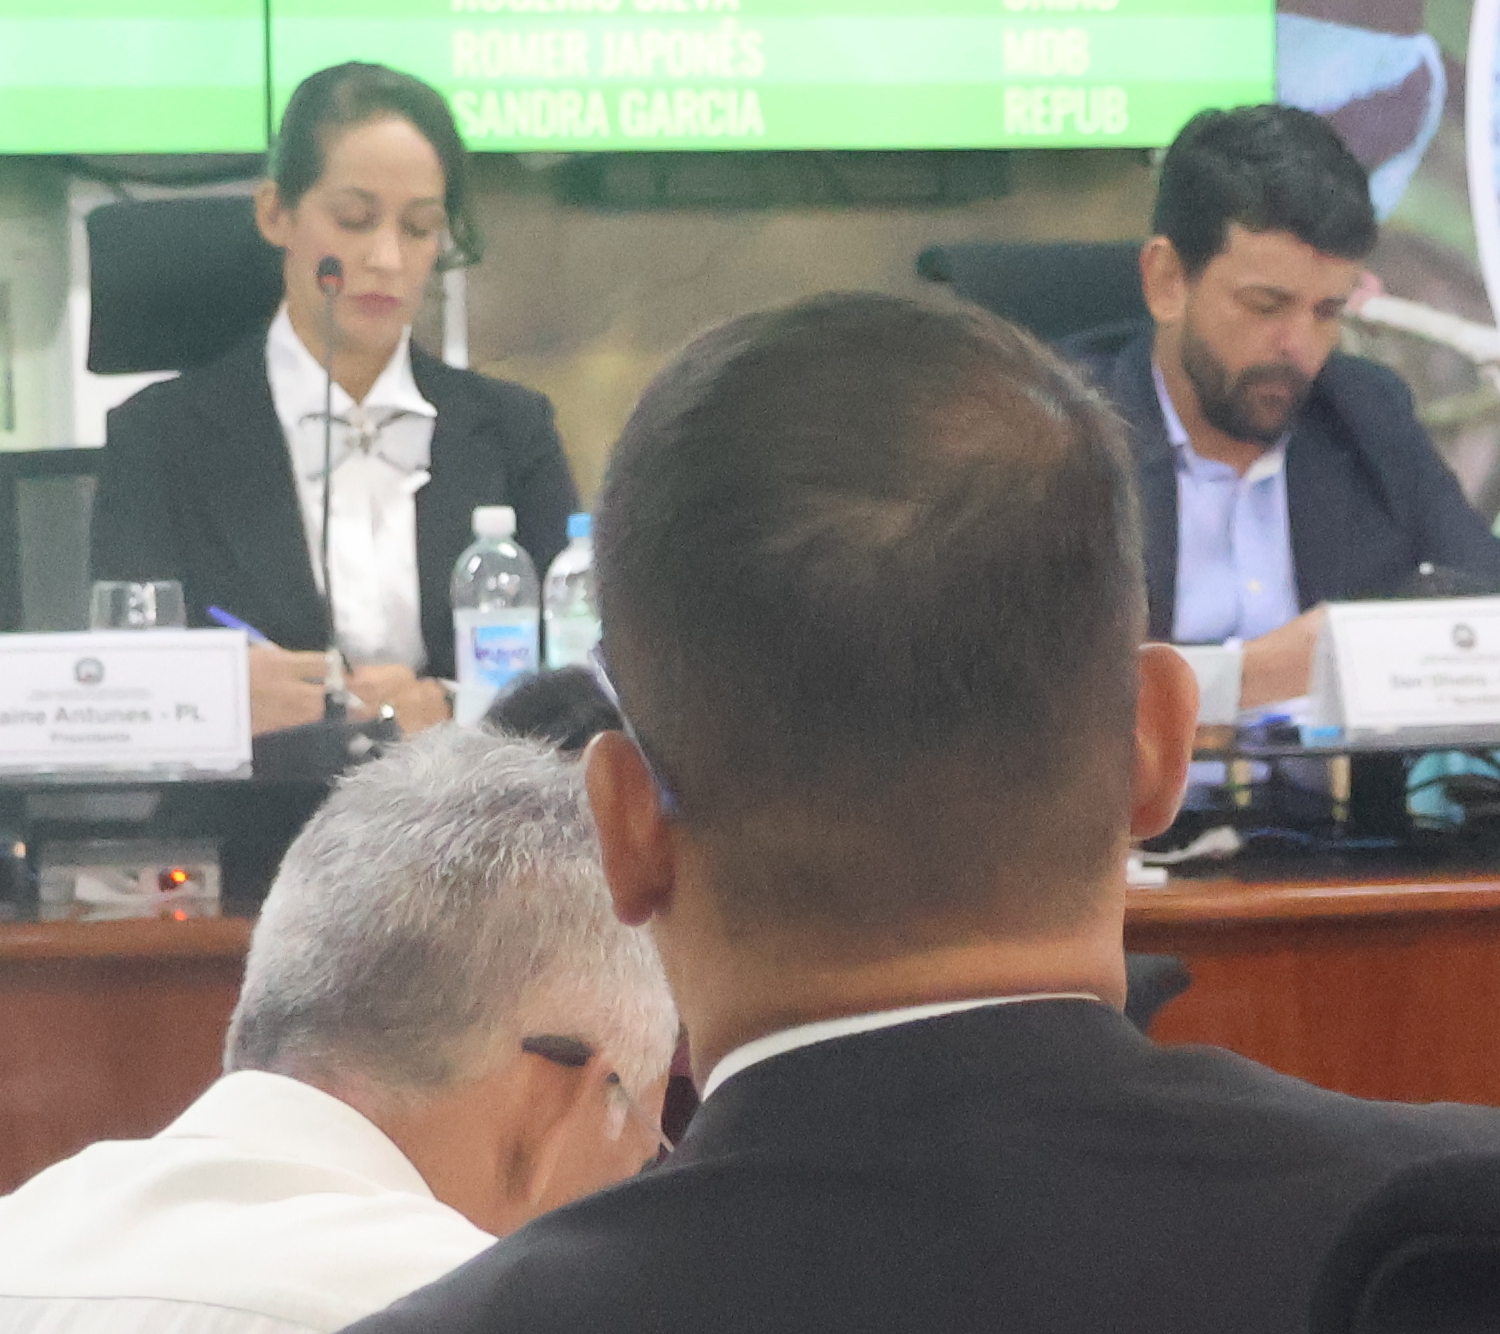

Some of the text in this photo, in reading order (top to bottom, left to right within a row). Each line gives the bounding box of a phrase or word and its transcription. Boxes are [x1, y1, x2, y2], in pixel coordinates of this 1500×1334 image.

[1002, 26, 1092, 78] MDB
[451, 87, 764, 139] SANDRA GARCIA
[1002, 84, 1130, 137] REPUB
[54, 705, 152, 723] Antunes
[175, 703, 206, 721] PL
